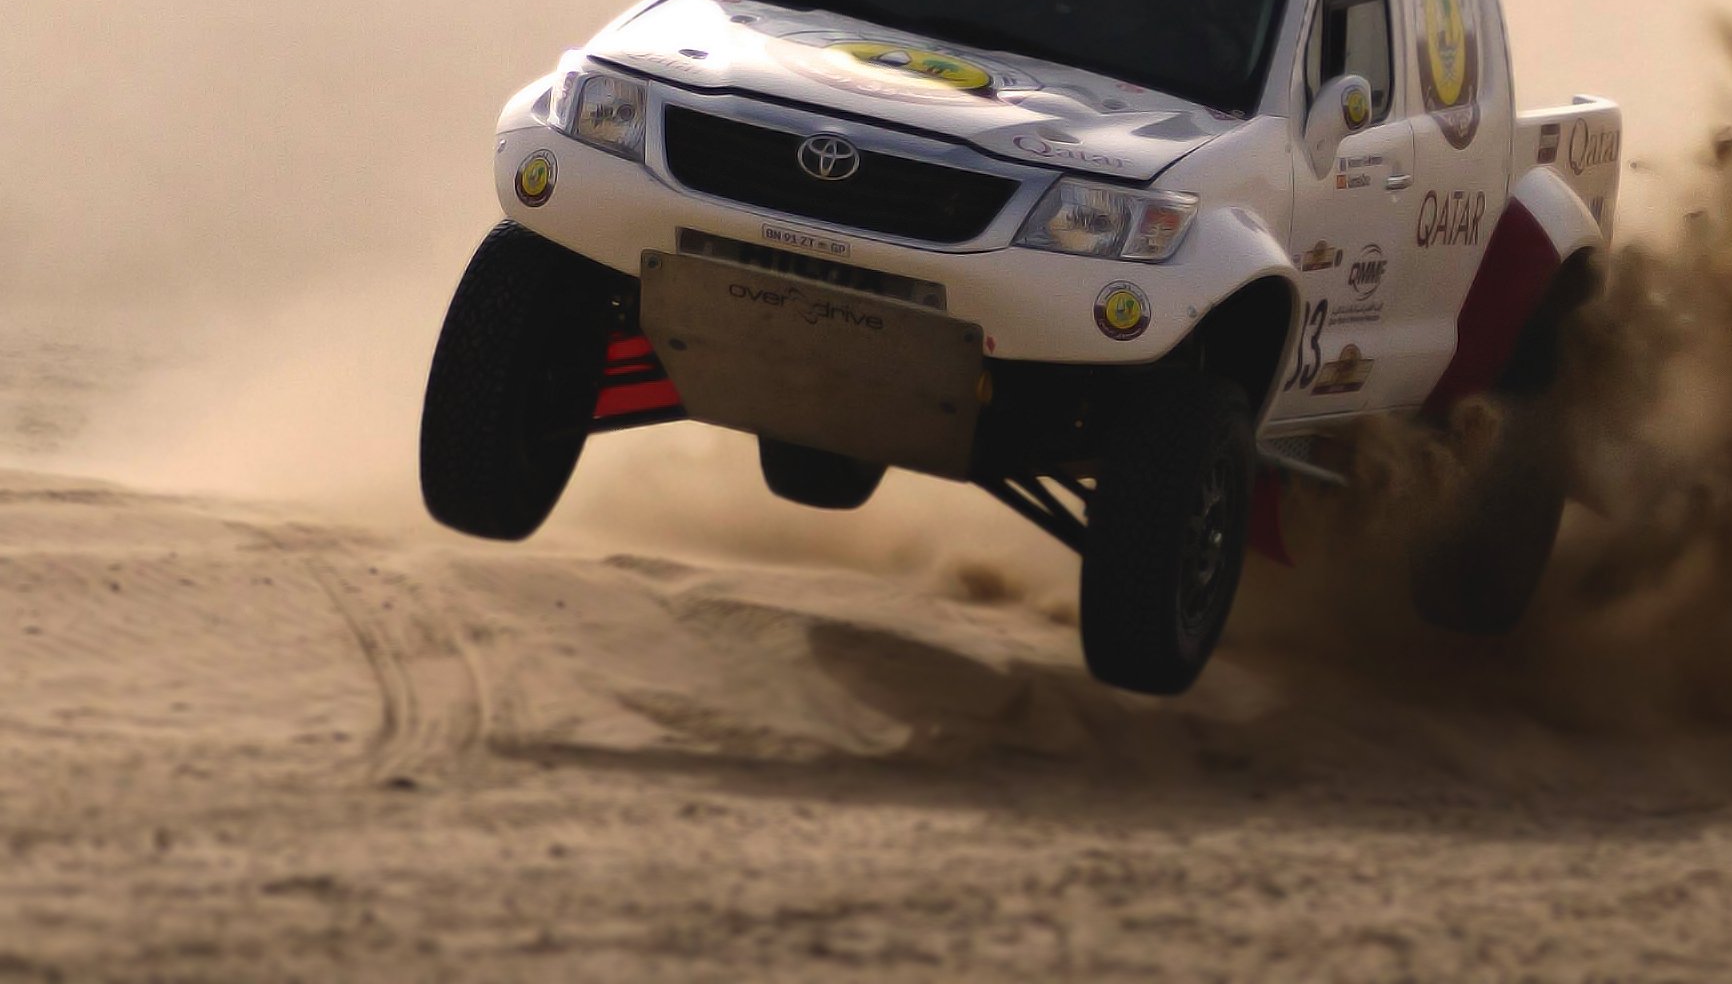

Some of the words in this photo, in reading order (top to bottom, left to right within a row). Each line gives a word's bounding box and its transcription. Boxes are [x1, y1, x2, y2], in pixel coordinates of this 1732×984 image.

[1012, 135, 1134, 168] Qatar
[1417, 190, 1486, 249] QATAR
[728, 283, 788, 307] over
[813, 302, 885, 330] drive
